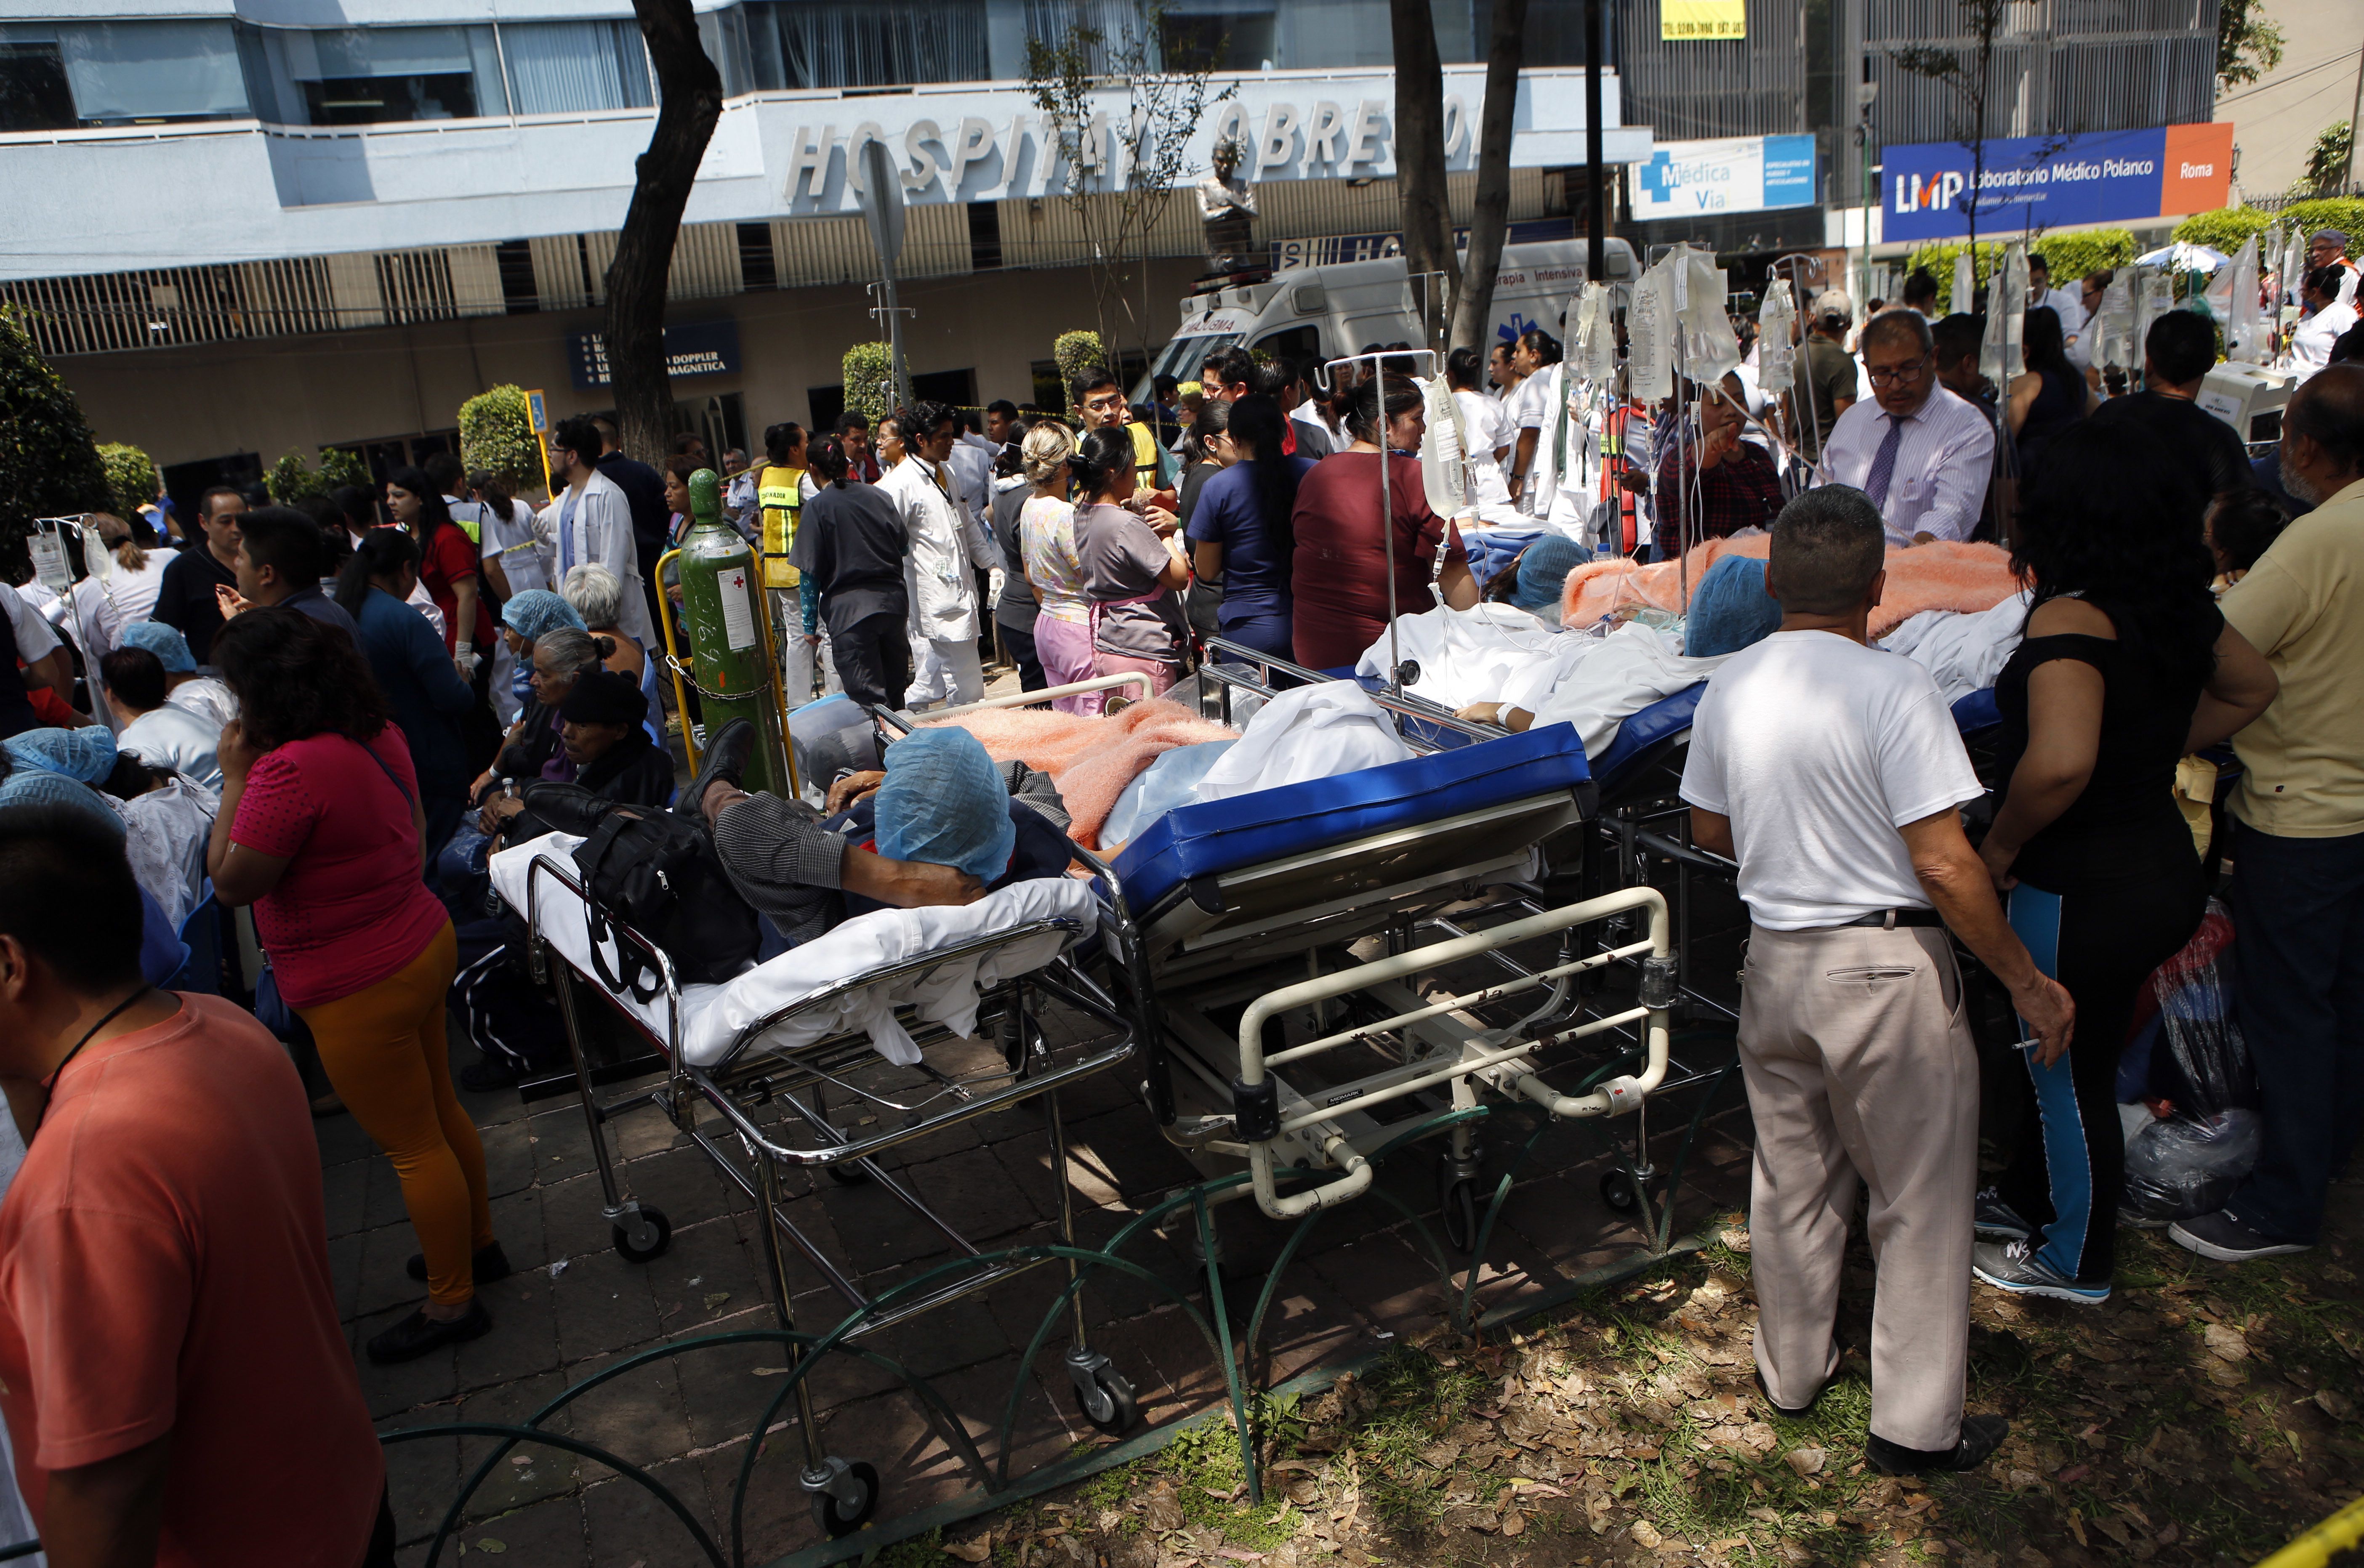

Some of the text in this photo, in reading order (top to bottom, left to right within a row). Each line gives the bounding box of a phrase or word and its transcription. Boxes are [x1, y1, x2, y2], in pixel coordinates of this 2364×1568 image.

[1215, 93, 1486, 169] OBREO
[1661, 163, 1730, 187] Médica
[2051, 158, 2101, 183] Médico
[2103, 157, 2154, 179] Polanco
[2180, 162, 2214, 179] Roma
[1895, 170, 1964, 214] LMP
[1535, 267, 1583, 284] Intensiva
[672, 351, 719, 364] DOPPLER
[667, 361, 726, 376] MAGNETICA
[1330, 1090, 1359, 1103] MIDMARK
